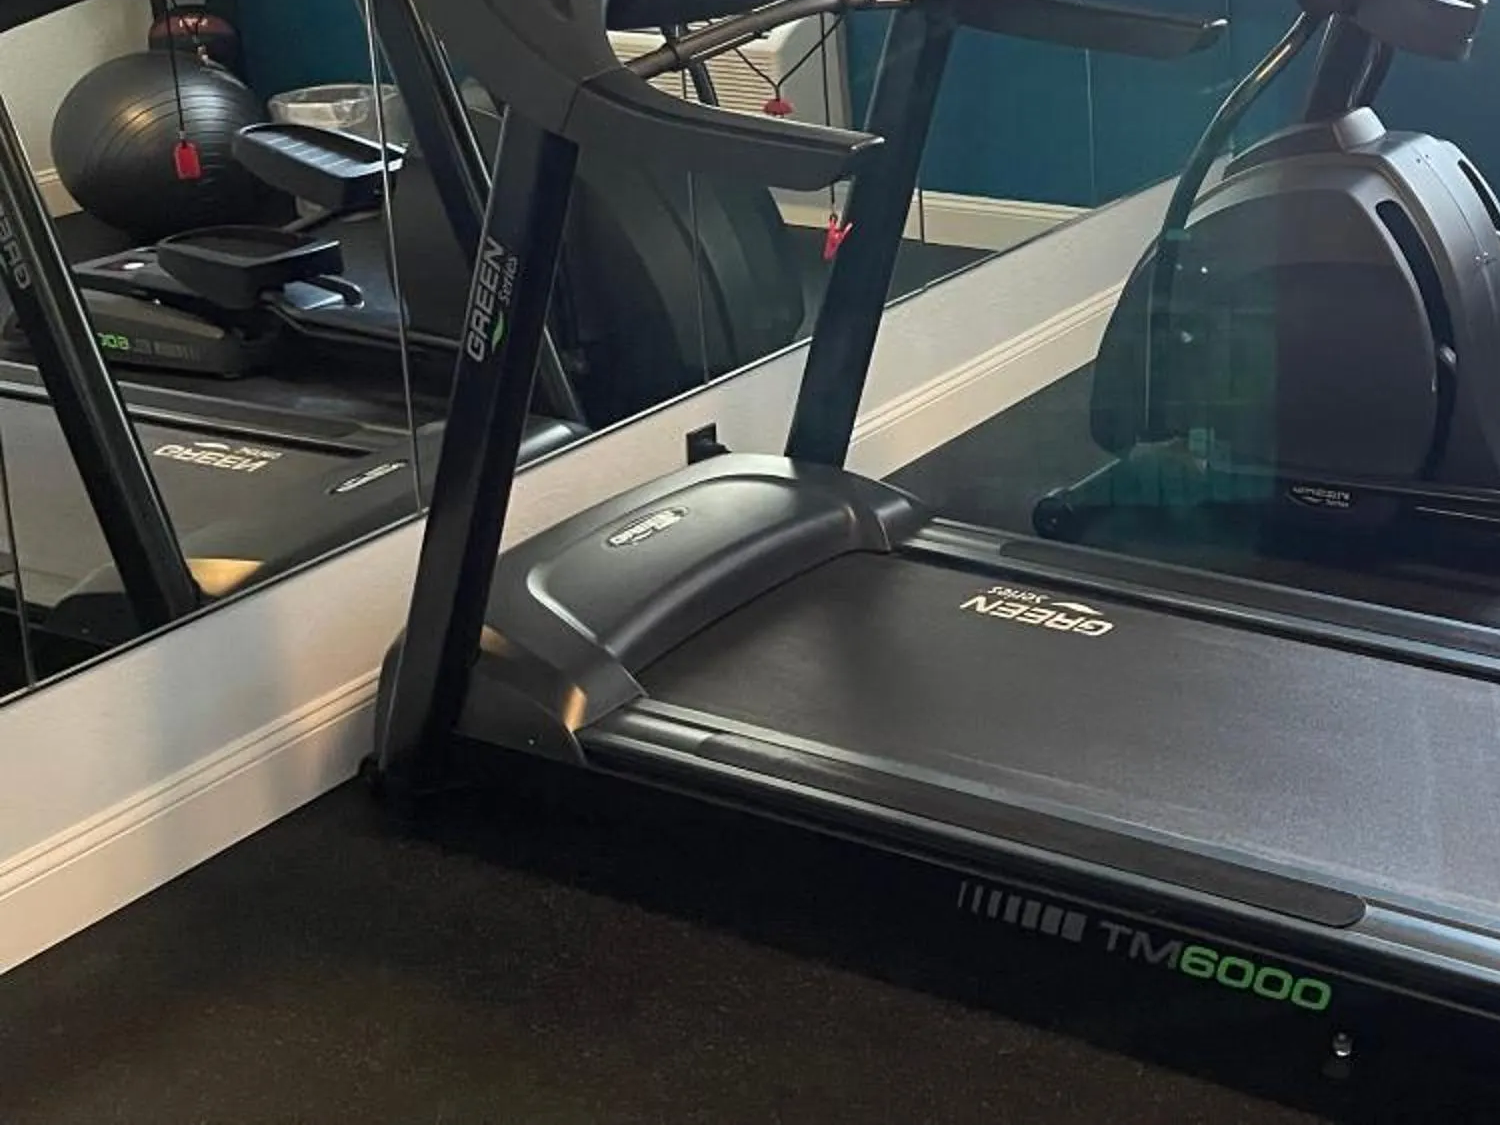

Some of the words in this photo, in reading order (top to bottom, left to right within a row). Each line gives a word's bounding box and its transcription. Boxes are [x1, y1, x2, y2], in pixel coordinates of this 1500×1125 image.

[466, 235, 505, 363] GREEN
[959, 595, 1114, 636] GREEN
[1101, 921, 1332, 1011] TM6000
